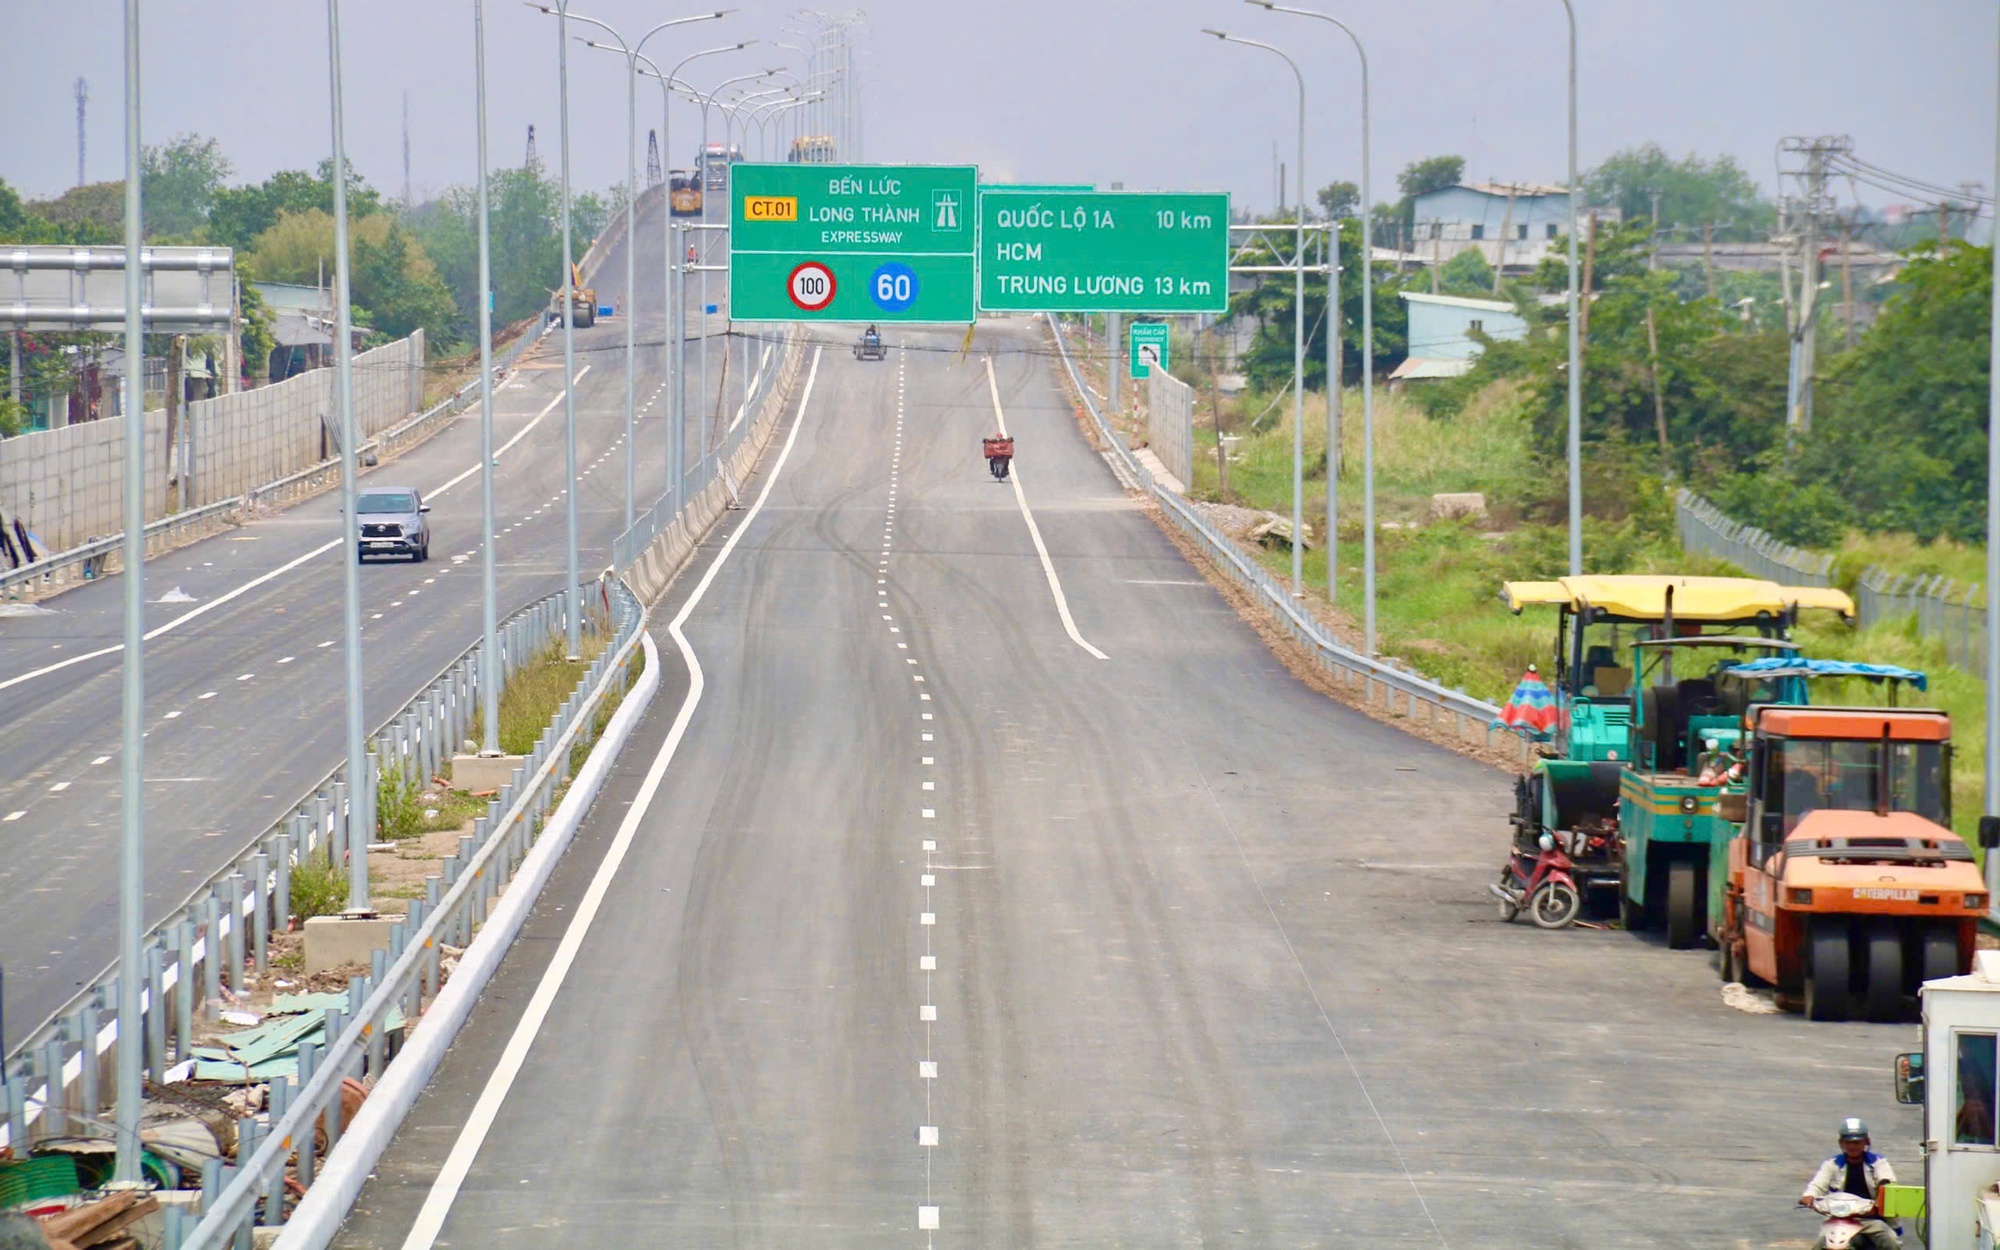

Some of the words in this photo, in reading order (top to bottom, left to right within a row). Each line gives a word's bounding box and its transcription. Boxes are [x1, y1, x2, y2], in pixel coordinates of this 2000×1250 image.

[829, 175, 863, 195] BẾN
[869, 176, 901, 196] LỨC
[752, 201, 791, 216] CT.01
[809, 207, 854, 222] LONG
[862, 203, 920, 223] THÀNH
[997, 203, 1055, 229] QUỐC
[1061, 206, 1087, 232] LỘ
[1093, 211, 1115, 229] 1A
[1156, 211, 1175, 229] 10
[1181, 211, 1212, 229] km
[821, 231, 902, 243] EXPRESSWAY
[997, 243, 1042, 261] HCM
[800, 277, 824, 295] 100
[877, 274, 910, 301] 60
[997, 276, 1067, 294] TRUNG
[1074, 275, 1144, 295] LƯƠNG
[1155, 277, 1174, 294] 13
[1179, 277, 1211, 295] km
[1853, 888, 1919, 901] CATERPILLAR
